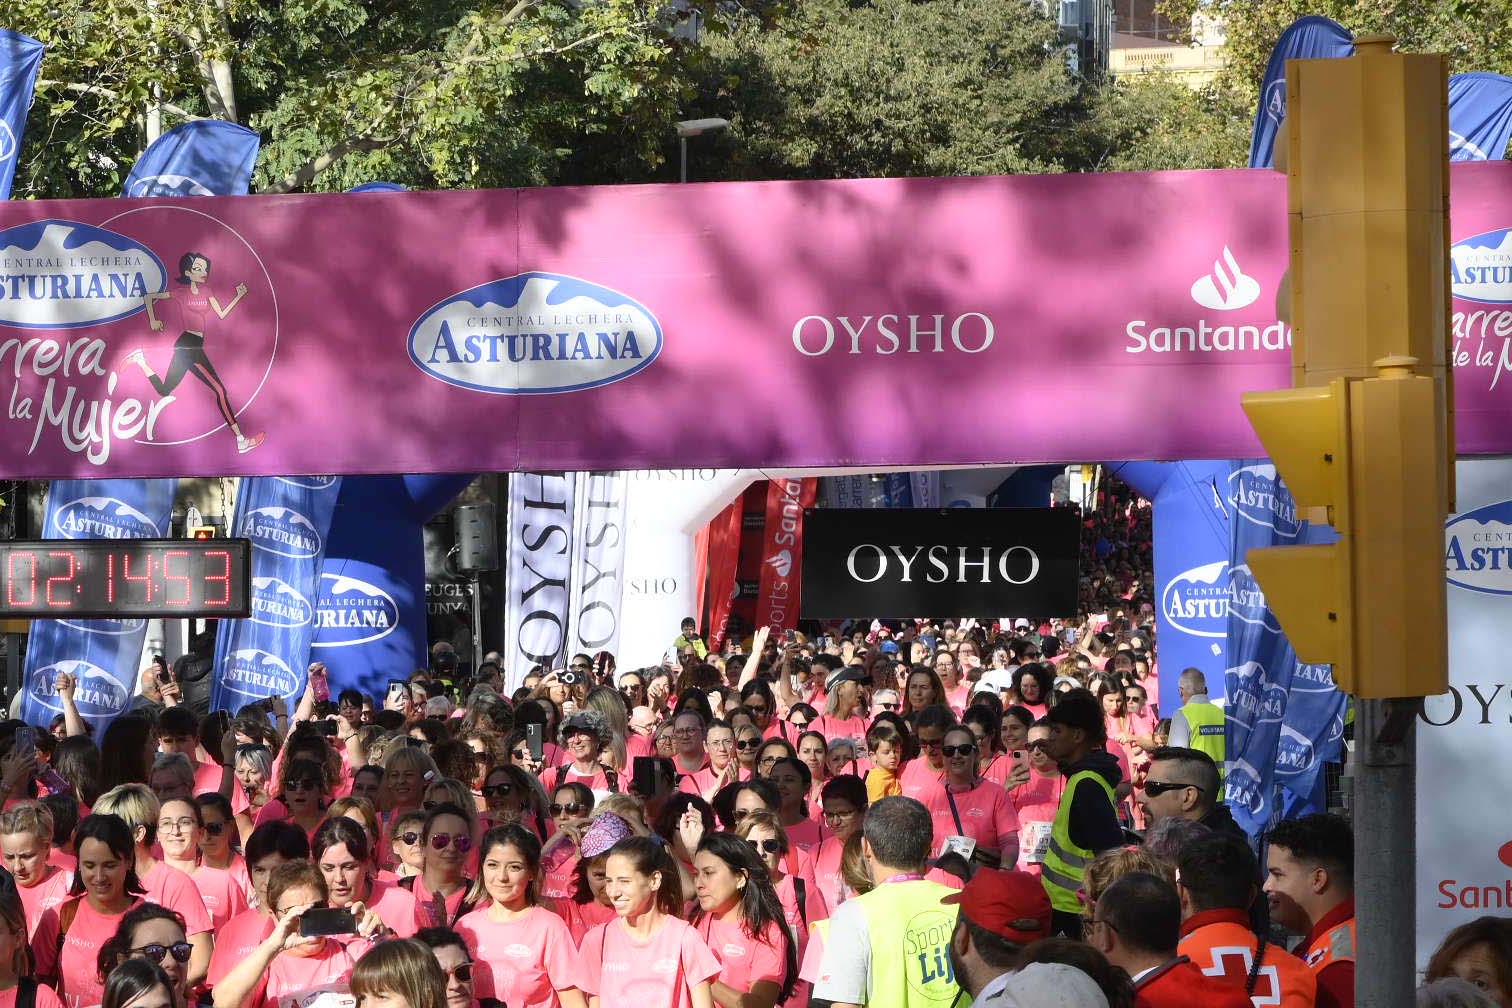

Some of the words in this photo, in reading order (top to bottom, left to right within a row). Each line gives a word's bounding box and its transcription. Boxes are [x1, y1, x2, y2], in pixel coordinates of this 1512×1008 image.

[68, 255, 144, 268] LECHERA
[466, 313, 547, 328] CENTRAL
[552, 312, 635, 326] LECHERA
[791, 311, 995, 357] OYSHO
[426, 319, 643, 364] ASTURIANA
[7, 384, 34, 421] la
[27, 373, 178, 466] Mujer
[244, 517, 317, 552] ASTURIANA
[846, 544, 1041, 586] OYSHO
[336, 598, 385, 606] LECHERA
[629, 577, 678, 596] SHO
[314, 608, 390, 629] URIANA
[906, 918, 954, 956] Sport
